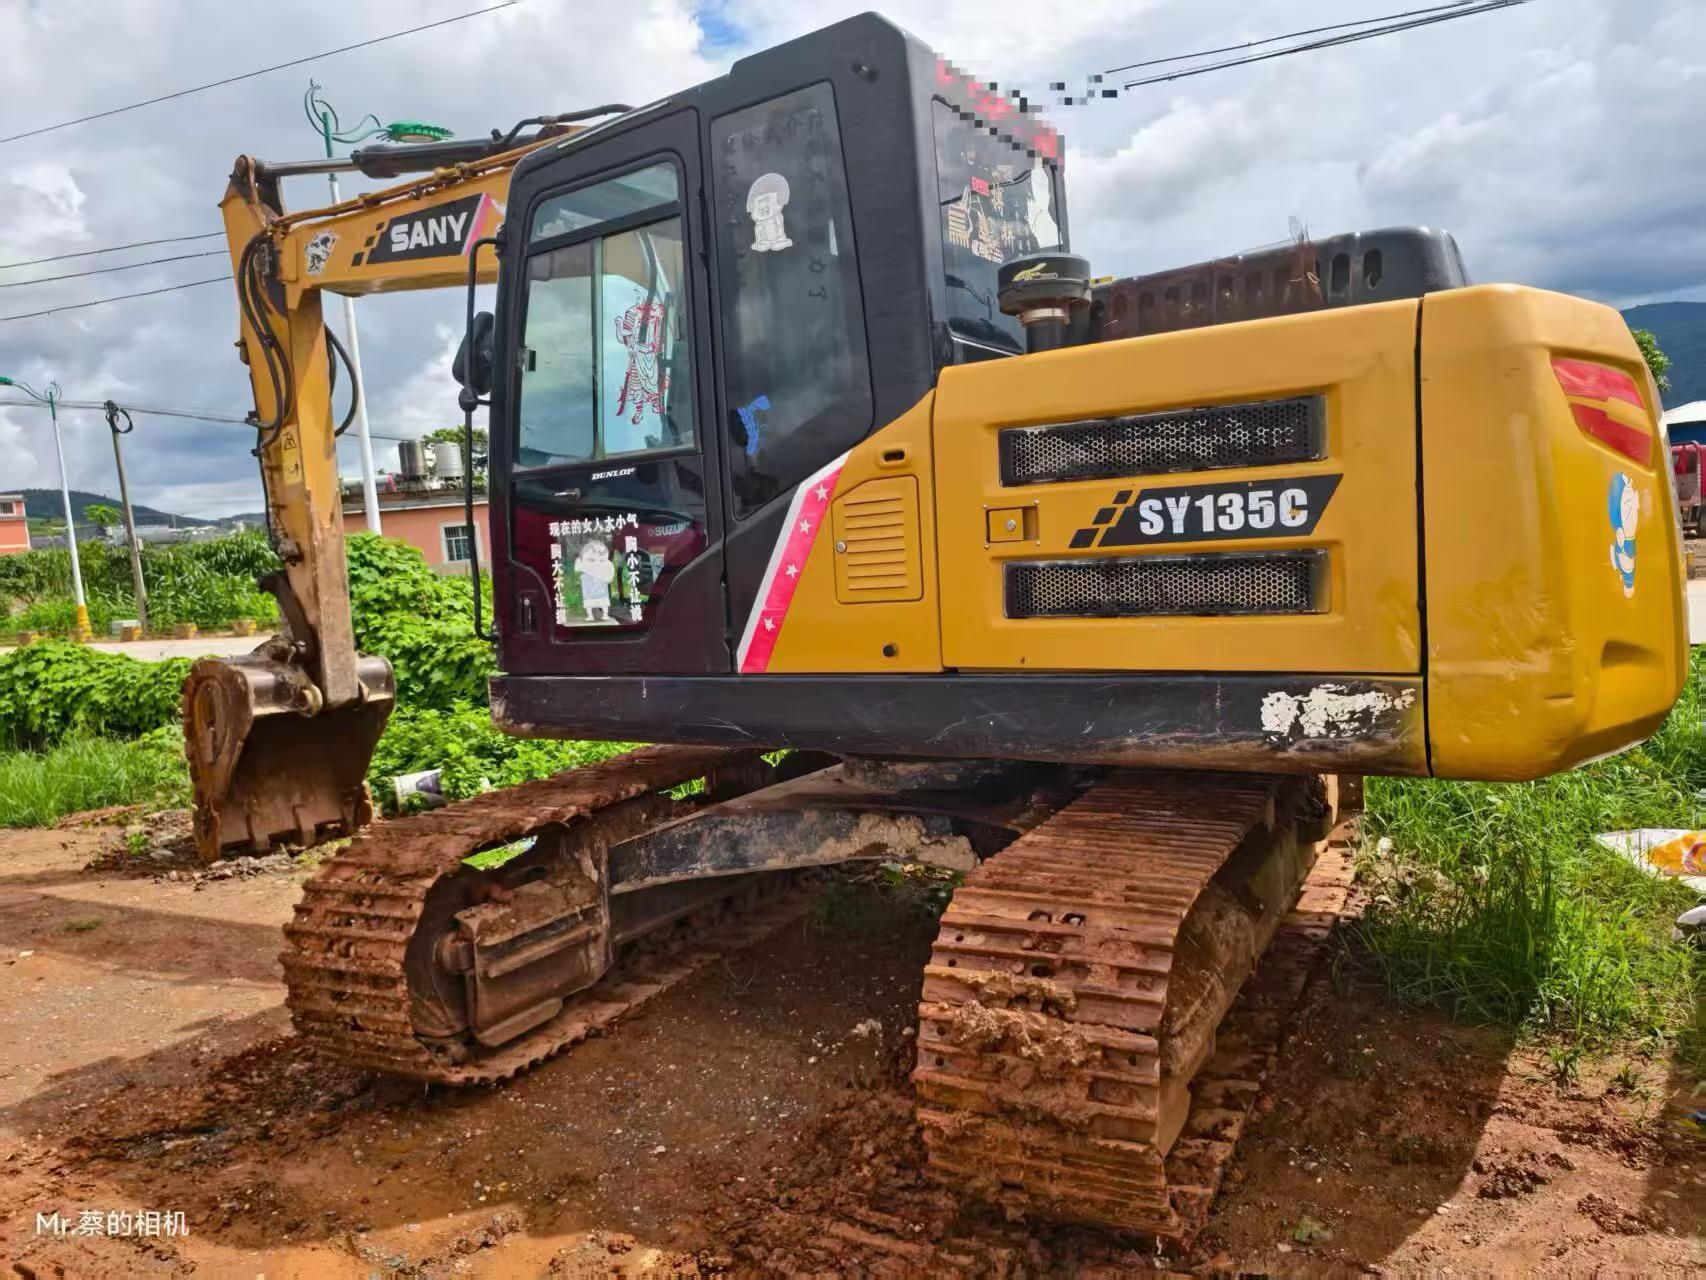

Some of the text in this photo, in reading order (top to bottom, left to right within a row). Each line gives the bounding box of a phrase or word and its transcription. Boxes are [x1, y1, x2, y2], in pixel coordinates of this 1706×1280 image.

[390, 211, 468, 252] SANY
[591, 467, 636, 481] DUNLOP
[549, 513, 639, 537] 现在的女人太小气
[1138, 488, 1308, 536] SY135C
